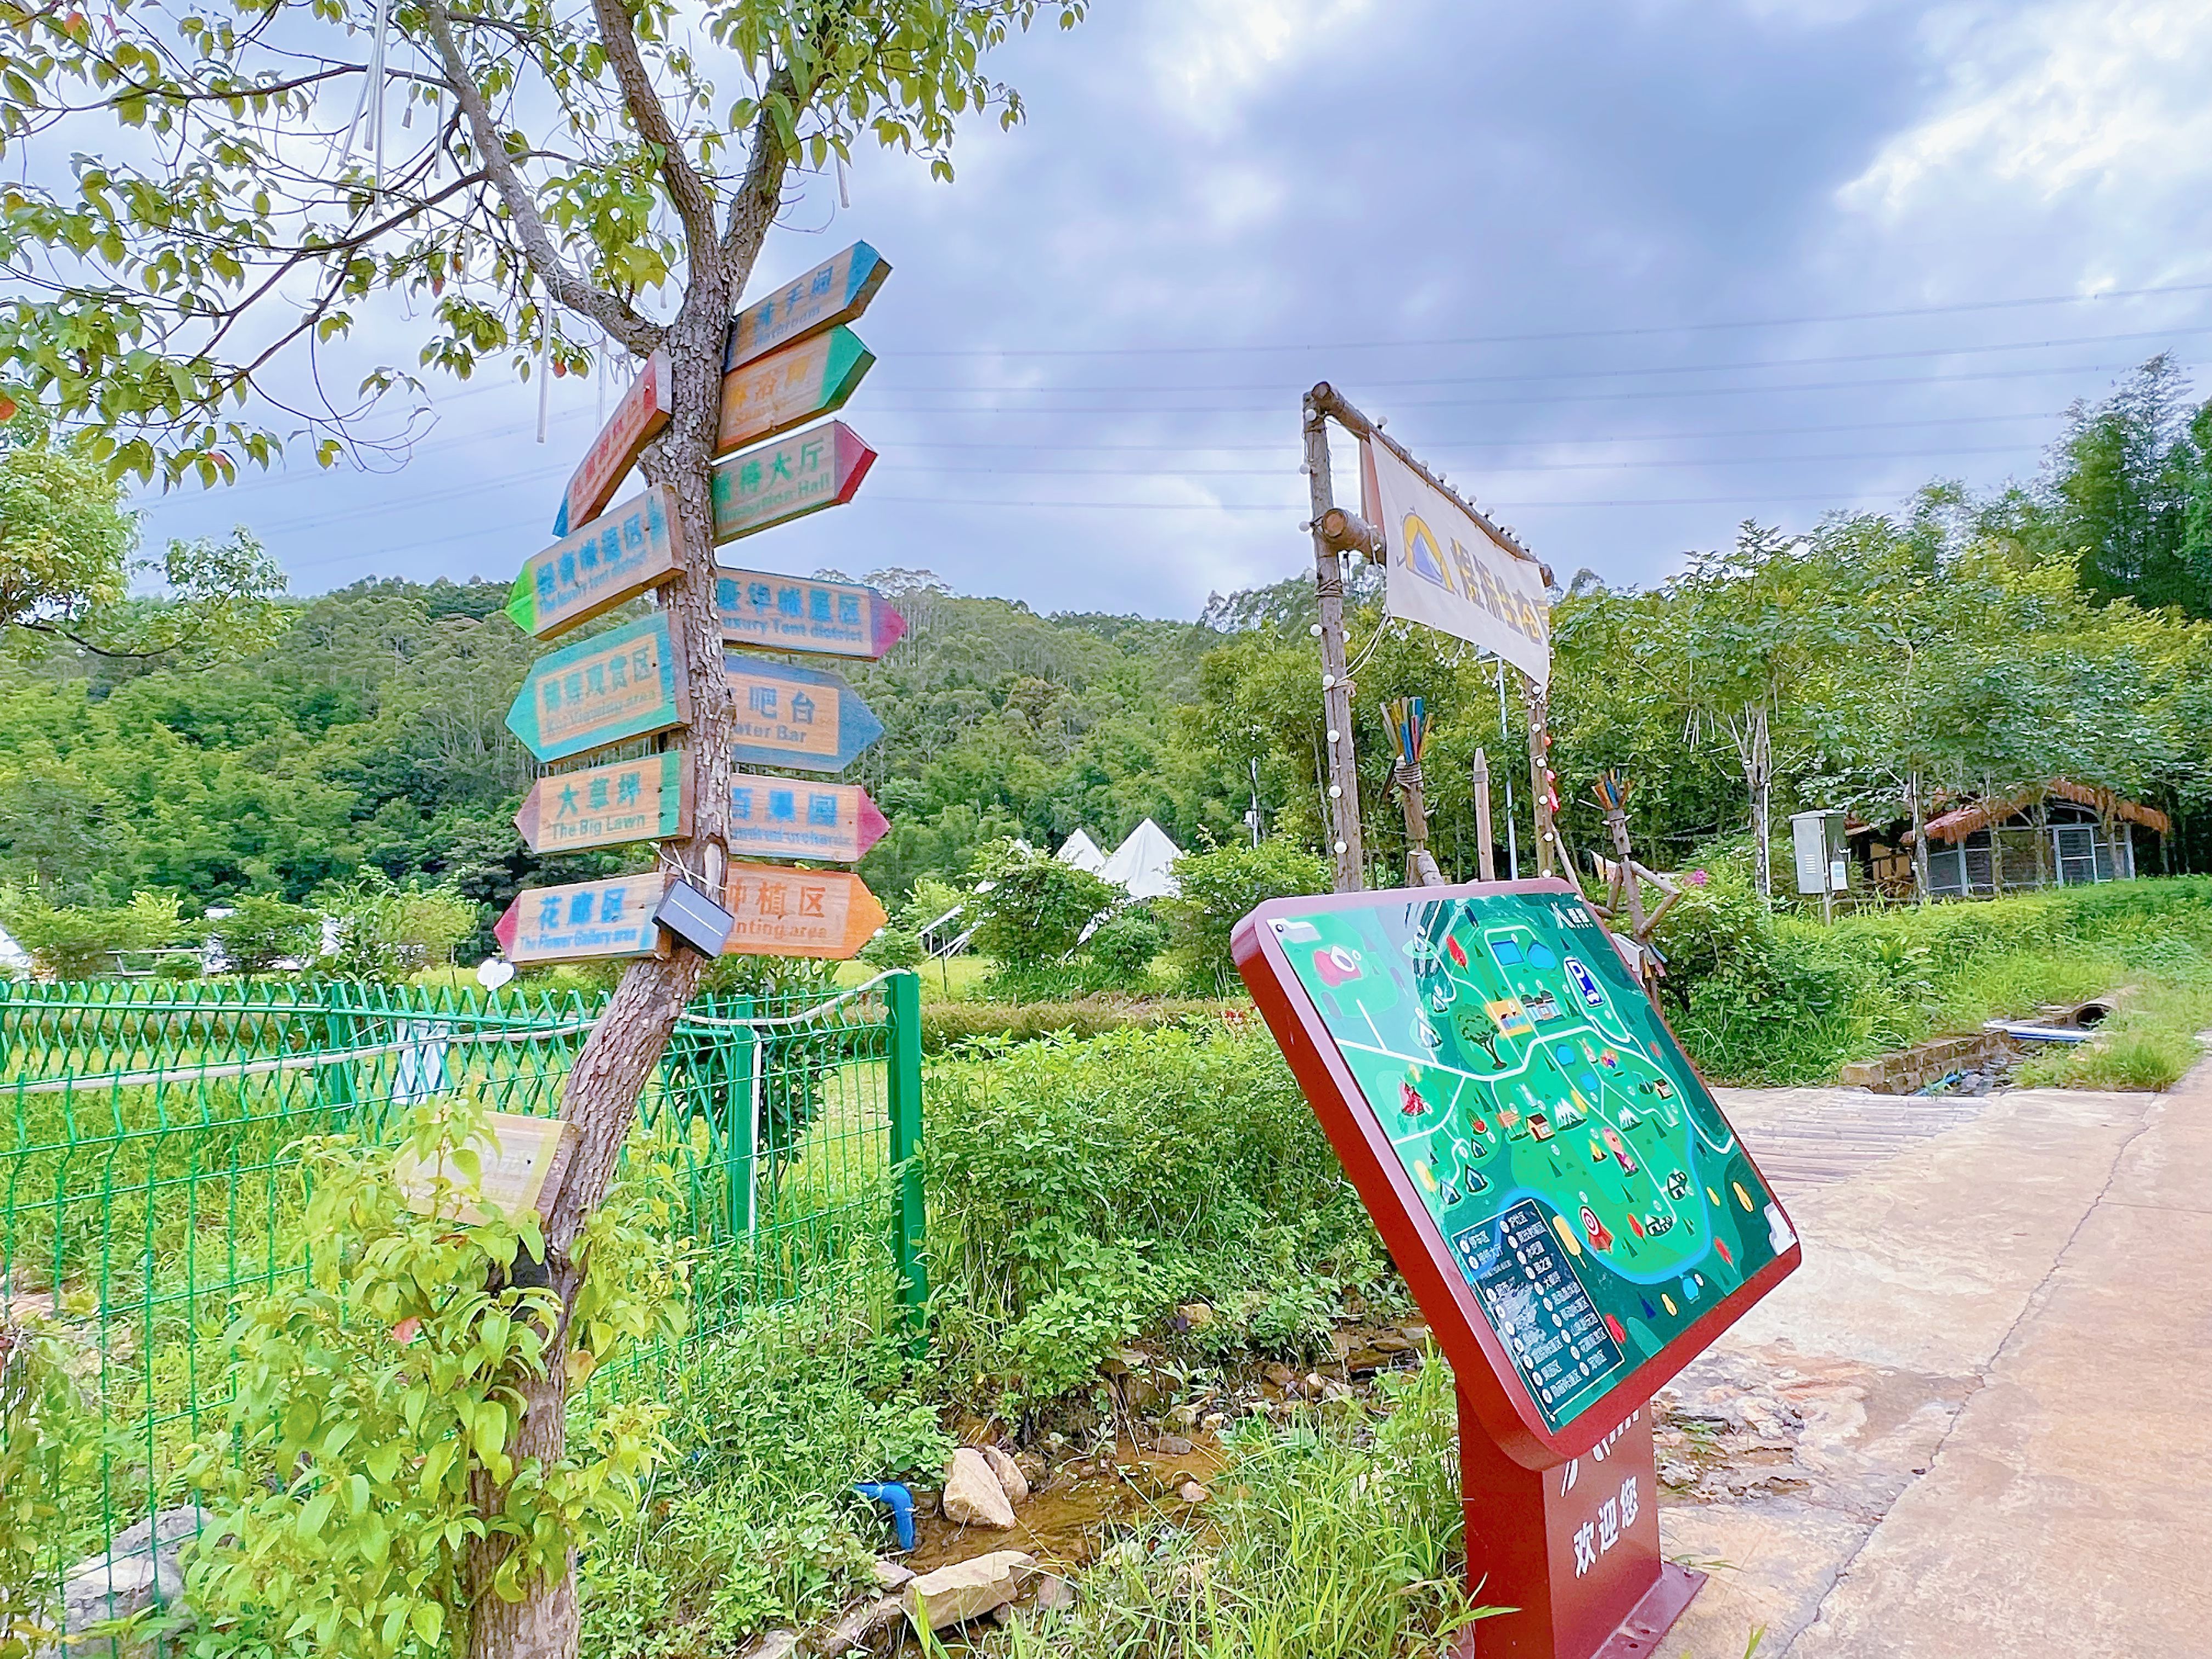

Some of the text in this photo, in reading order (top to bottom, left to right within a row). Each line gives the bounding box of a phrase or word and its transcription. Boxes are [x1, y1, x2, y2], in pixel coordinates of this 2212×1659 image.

[732, 686, 815, 725] 吧台
[733, 722, 807, 743] ater Bar
[556, 771, 641, 820] 大草坪
[552, 814, 646, 840] The Big Lawn
[736, 918, 827, 940] nting area
[1573, 1476, 1639, 1579] 欢迎您
